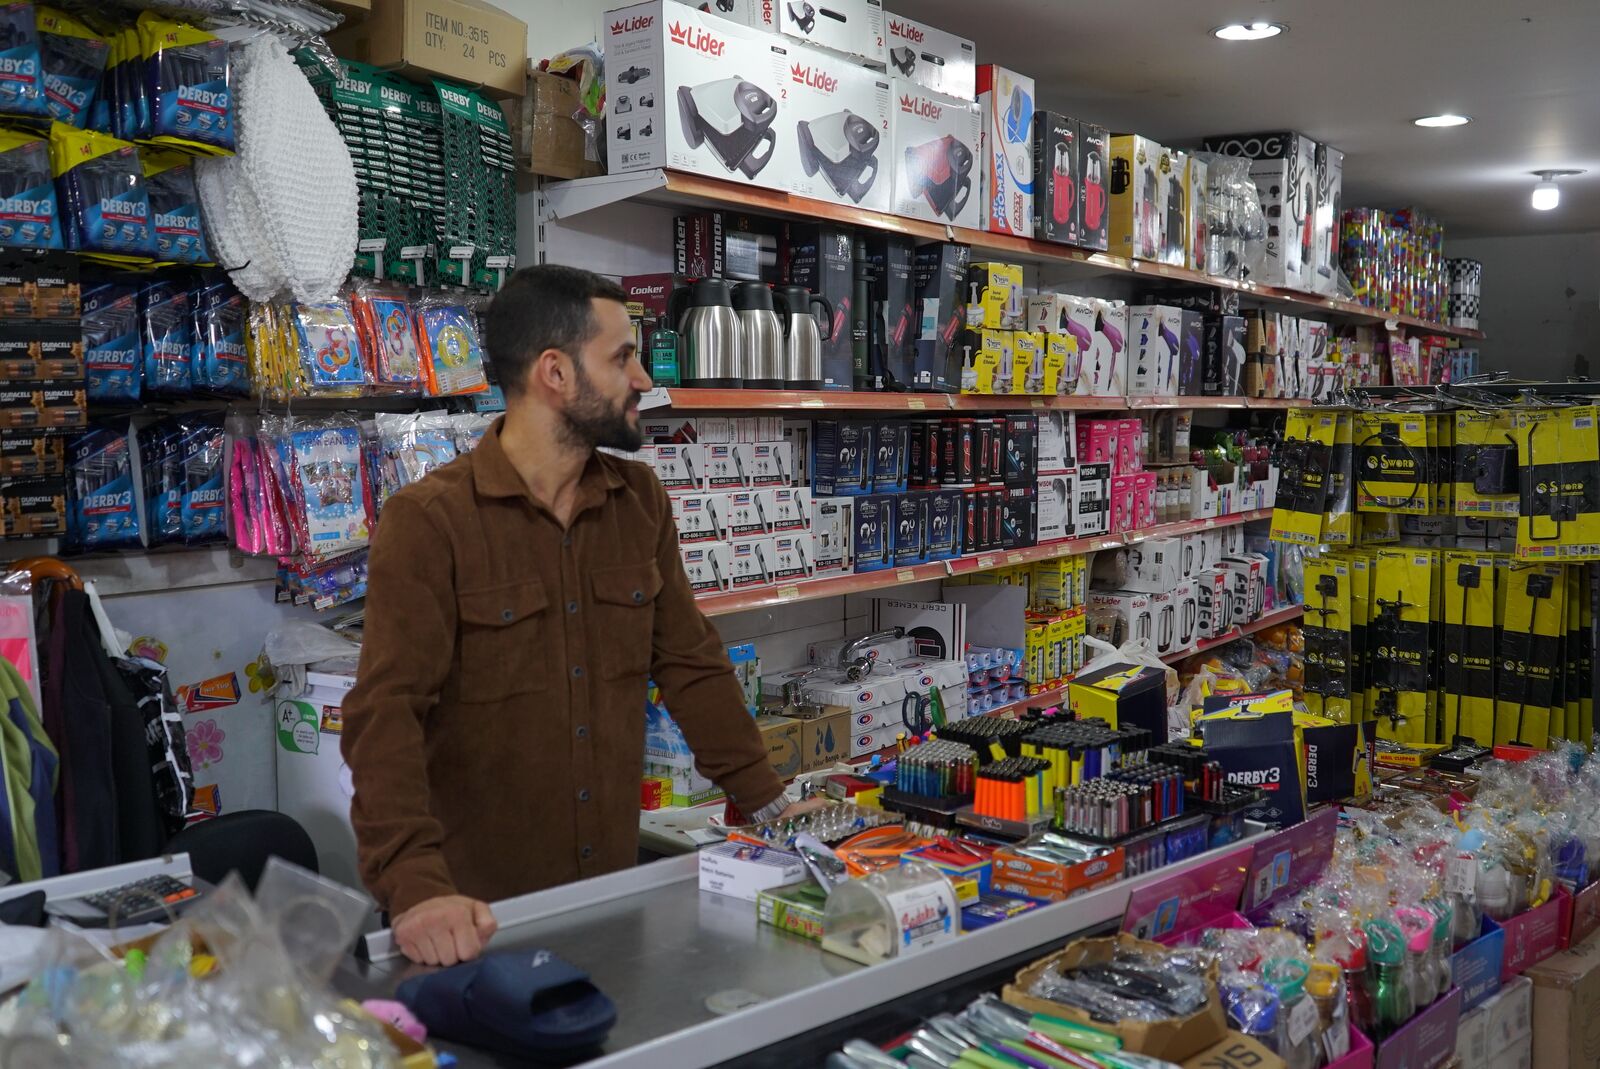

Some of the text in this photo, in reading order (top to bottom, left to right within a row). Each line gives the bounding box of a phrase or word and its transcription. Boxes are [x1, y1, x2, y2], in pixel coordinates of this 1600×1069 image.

[763, 0, 772, 24] ider
[425, 11, 448, 33] ITEM
[625, 16, 654, 33] Lider
[687, 26, 725, 57] Lider
[900, 20, 924, 44] Lider
[425, 32, 506, 69] QTY: 24 PCS
[877, 37, 882, 47] 2
[0, 58, 36, 76] RBY3
[335, 77, 373, 95] DERBY
[806, 66, 838, 93] Lider
[381, 86, 412, 105] DERBY
[441, 88, 471, 108] DERBY
[781, 89, 787, 99] 2
[477, 102, 502, 121] DERBY
[914, 97, 942, 120] Lider
[883, 120, 888, 130] 2
[1053, 127, 1073, 138] AWOX
[676, 216, 686, 275] ooker
[711, 212, 722, 279] Termos
[630, 285, 664, 296] Cooker
[887, 601, 918, 610] KEMER
[1101, 597, 1121, 605] Lider
[1307, 743, 1318, 788] DERBY3
[1395, 755, 1416, 763] CLIPPER
[1227, 766, 1281, 785] DERBY3
